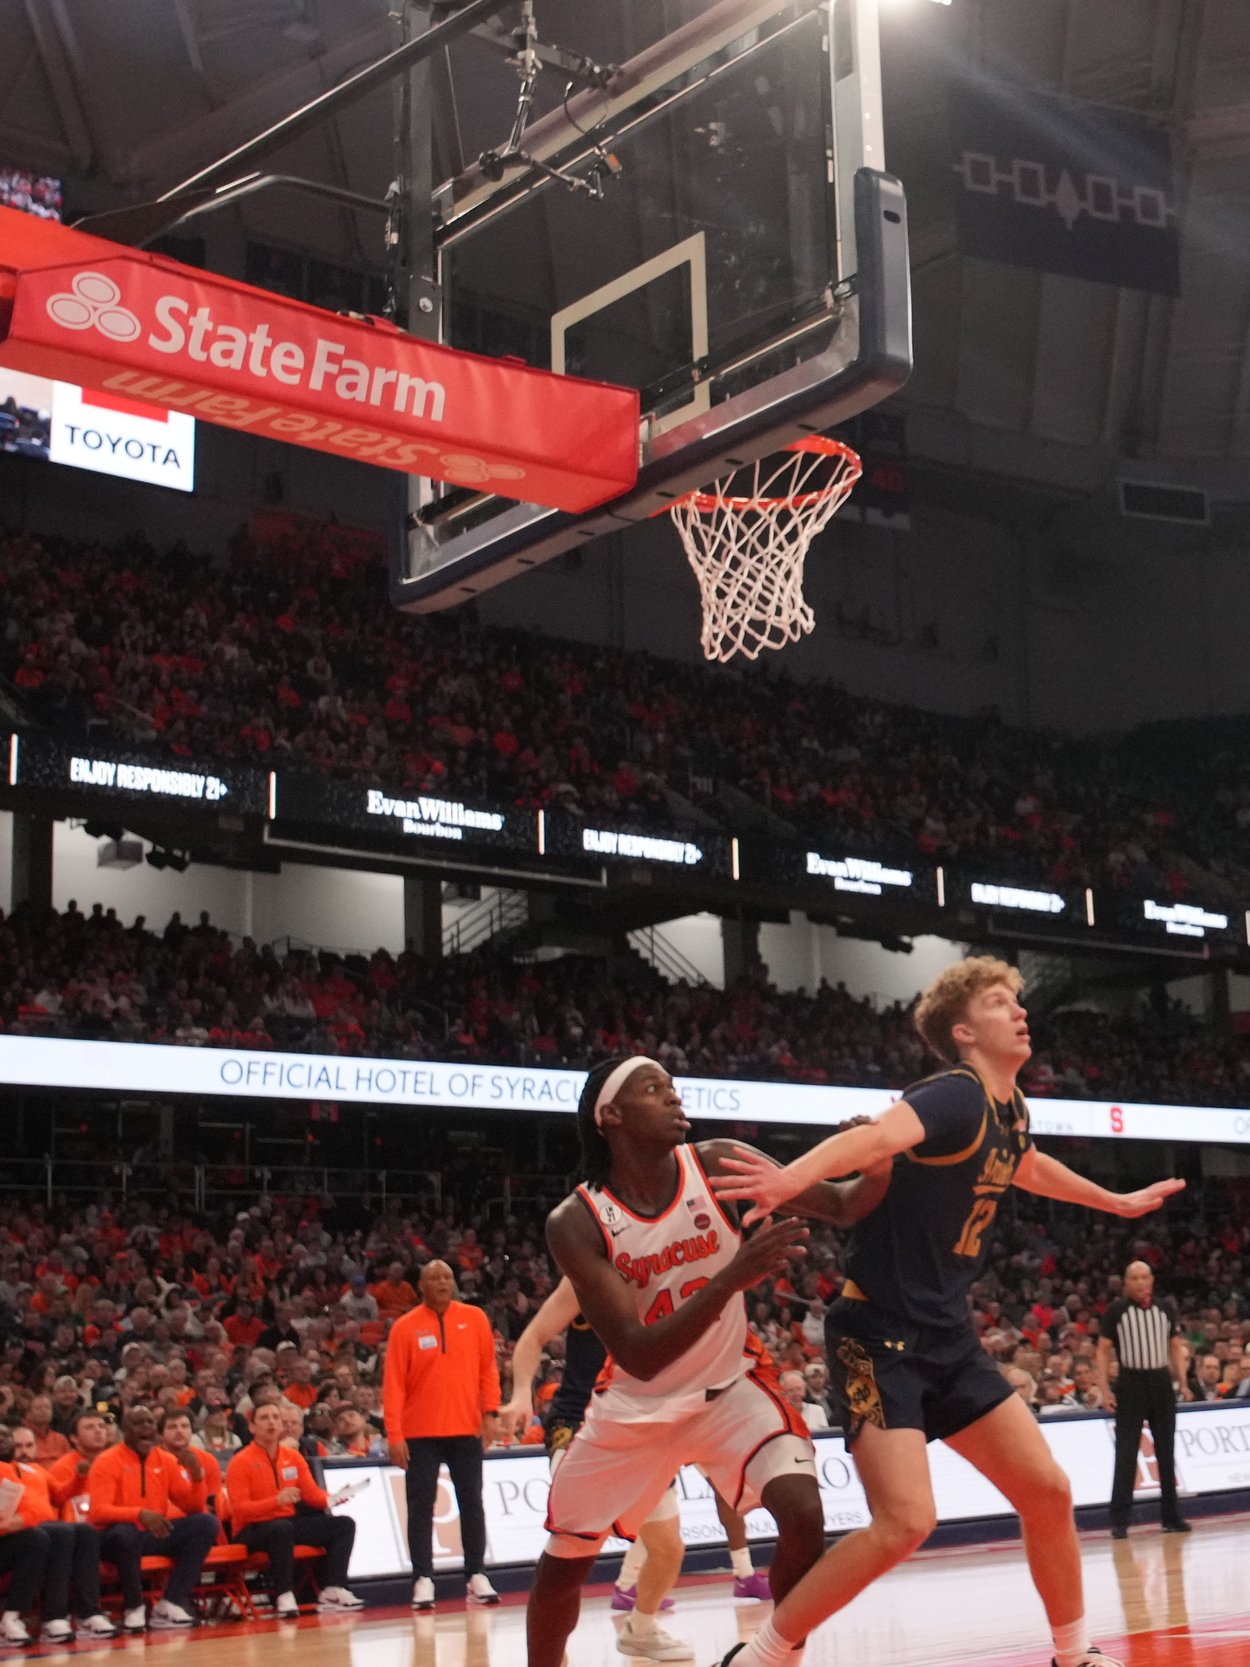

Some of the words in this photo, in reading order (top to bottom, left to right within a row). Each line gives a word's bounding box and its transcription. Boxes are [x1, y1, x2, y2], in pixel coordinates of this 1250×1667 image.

[65, 424, 181, 469] TOYOTA
[70, 757, 117, 787] ENJOY
[116, 764, 206, 799] RESPONSIBLY
[220, 1058, 347, 1092] OFFICIAL
[355, 1068, 440, 1097] HOTEL
[447, 1072, 485, 1098] OF
[681, 1086, 741, 1112] ETICS
[615, 1230, 720, 1290] Syracuse
